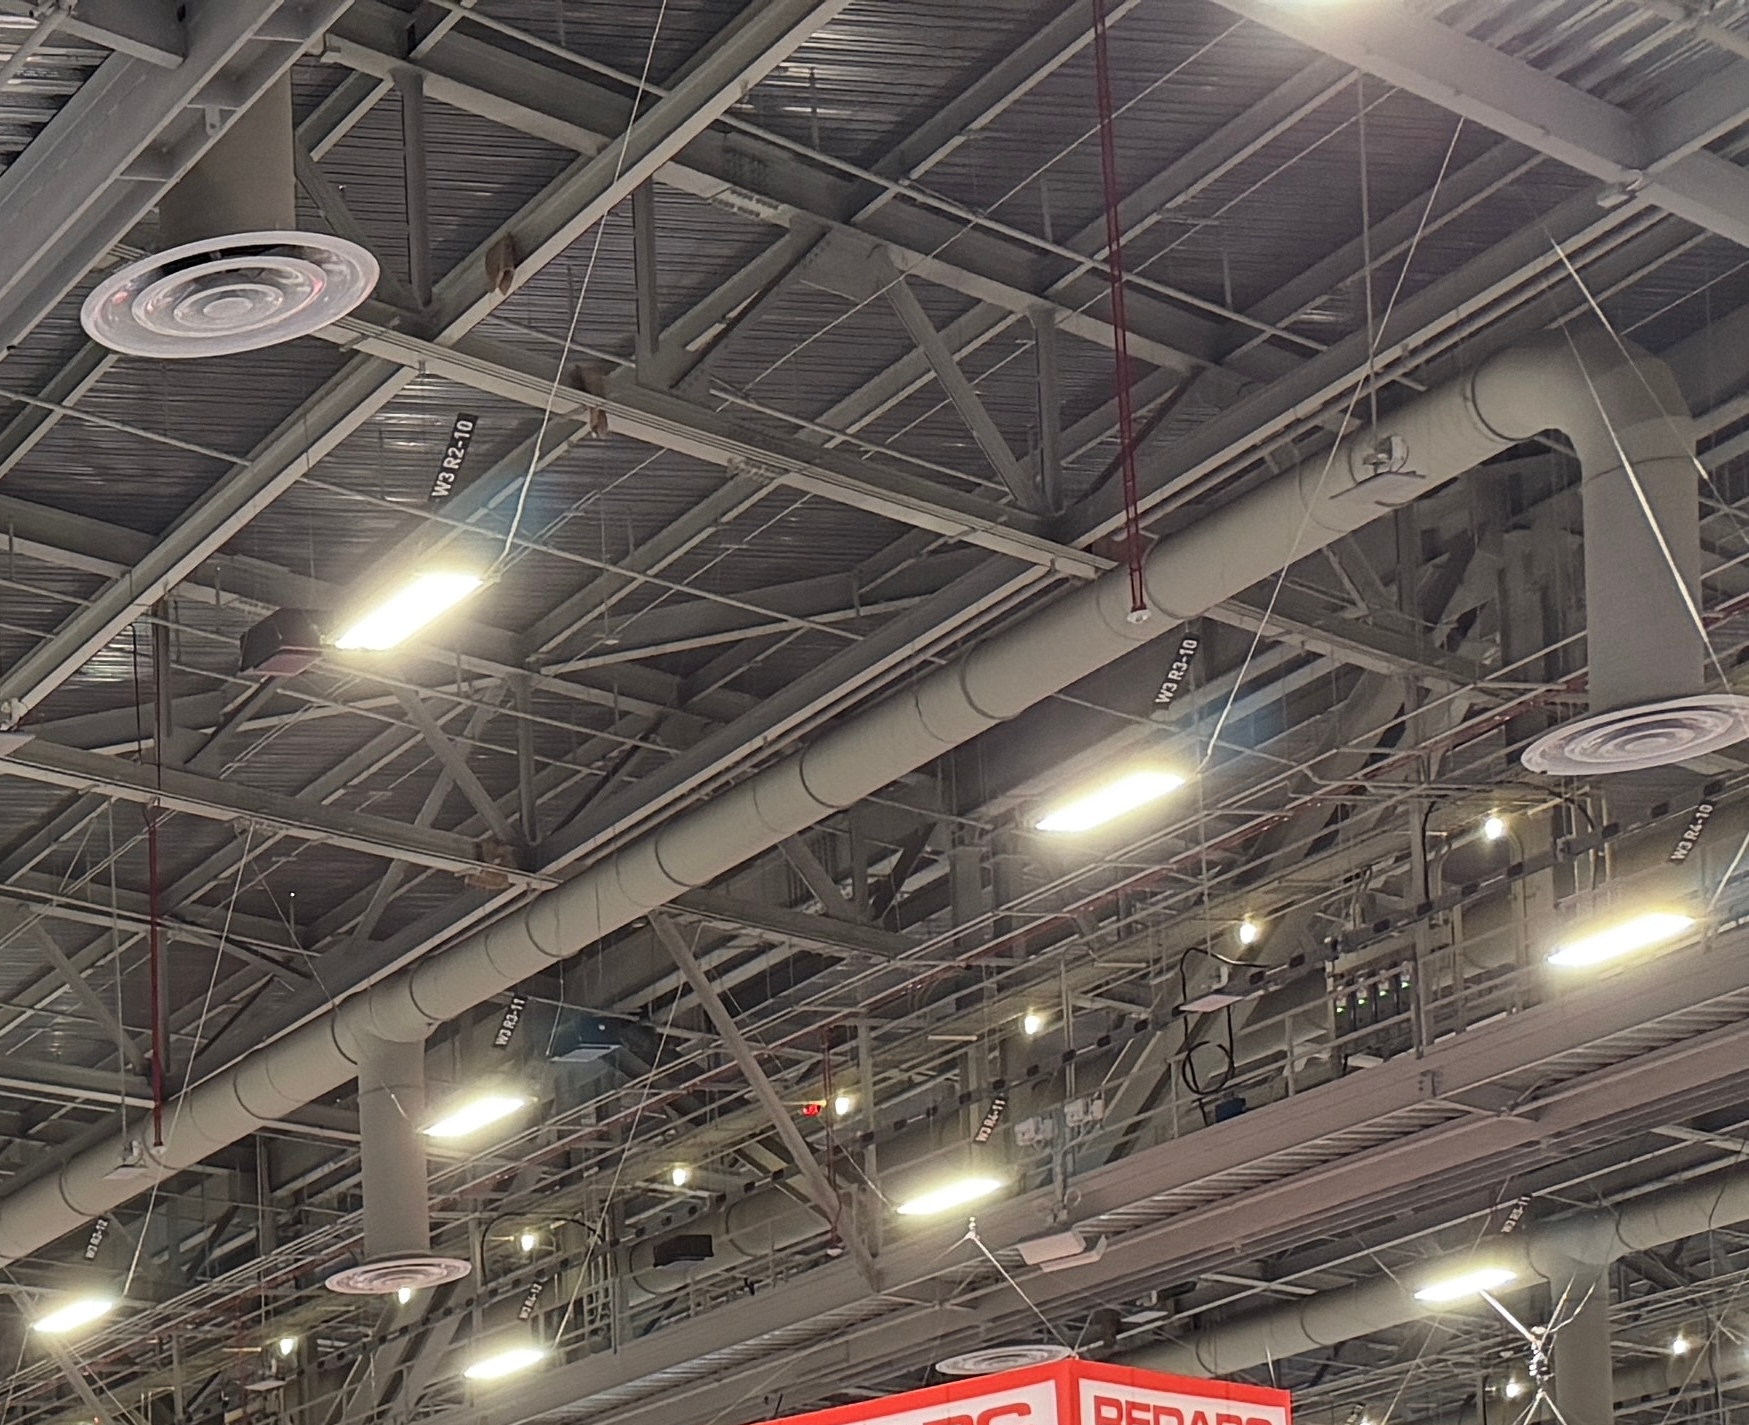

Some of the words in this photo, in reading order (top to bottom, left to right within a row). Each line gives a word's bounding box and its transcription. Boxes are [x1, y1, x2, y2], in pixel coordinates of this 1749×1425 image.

[432, 473, 455, 499] W3
[444, 421, 474, 470] R2-10
[1155, 682, 1177, 704] W3
[1170, 639, 1198, 681] R3-10
[1671, 841, 1692, 860] W3
[1684, 804, 1712, 840] R4-10
[495, 1028, 511, 1045] W3
[504, 998, 524, 1029] R3-11
